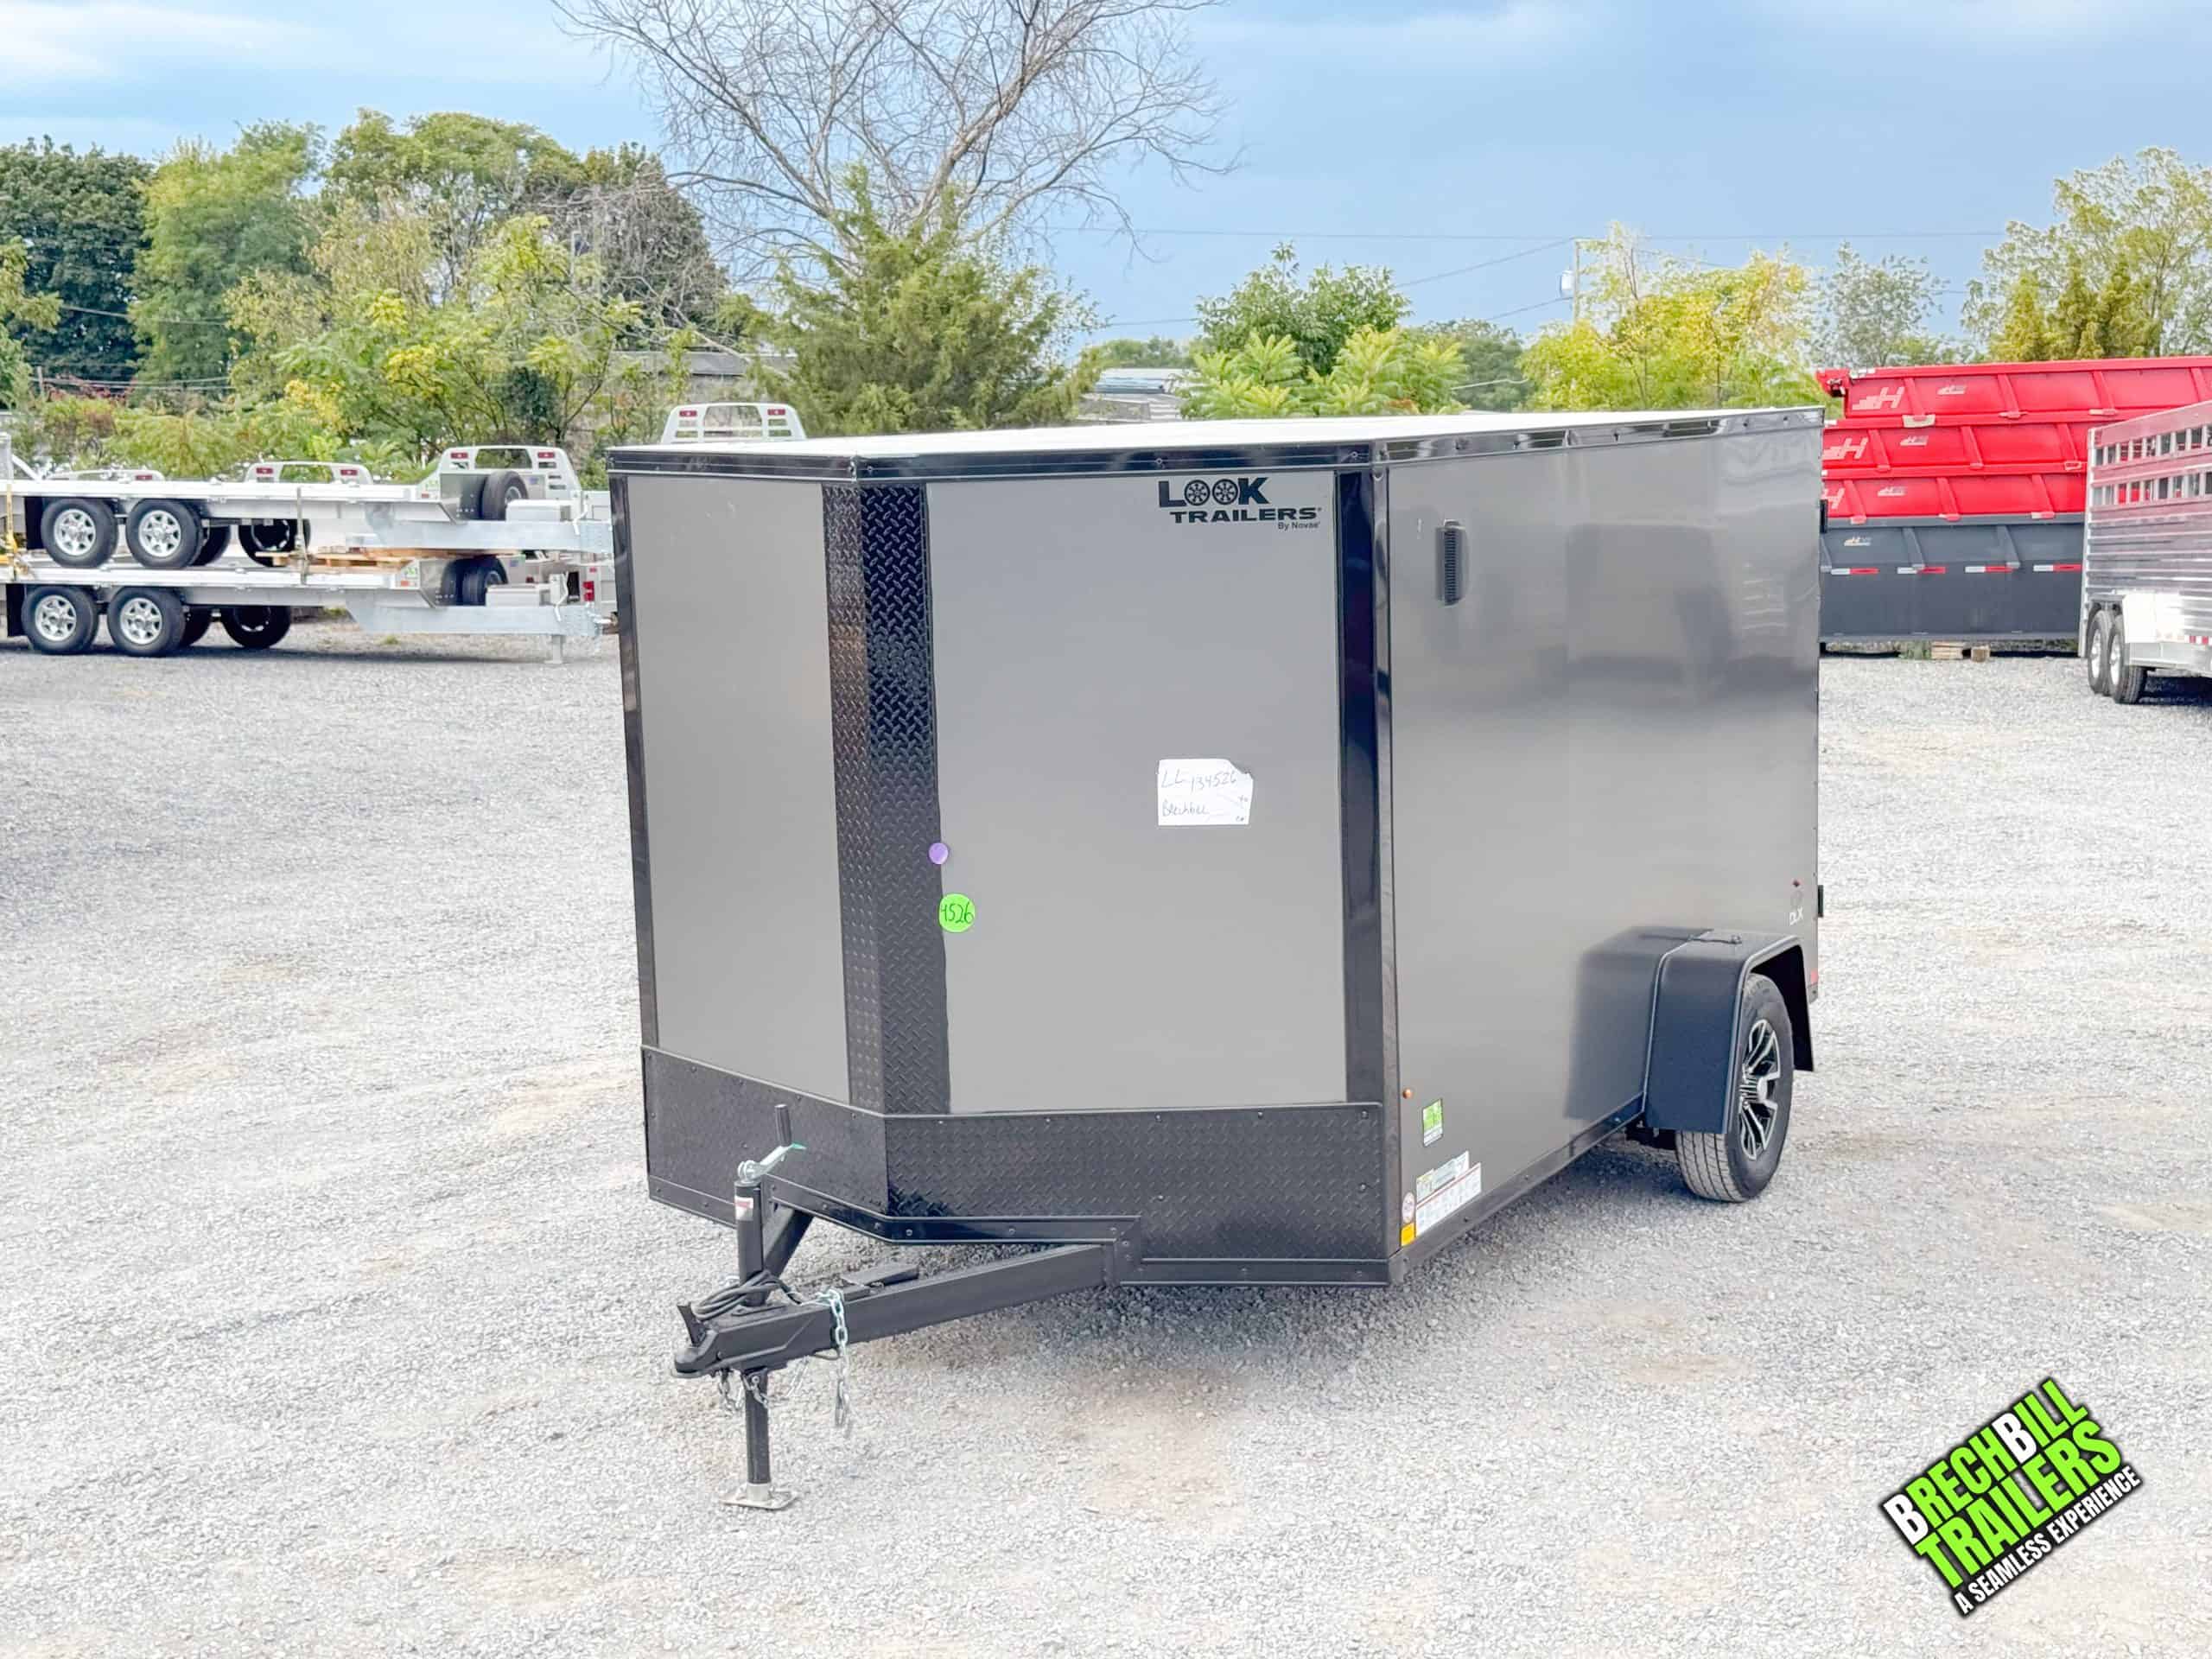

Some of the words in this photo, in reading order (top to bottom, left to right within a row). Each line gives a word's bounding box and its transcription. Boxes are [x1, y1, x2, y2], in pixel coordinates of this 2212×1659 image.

[1158, 477, 1270, 507] LOOK
[1169, 507, 1318, 524] TRAILERS
[1278, 522, 1290, 531] By
